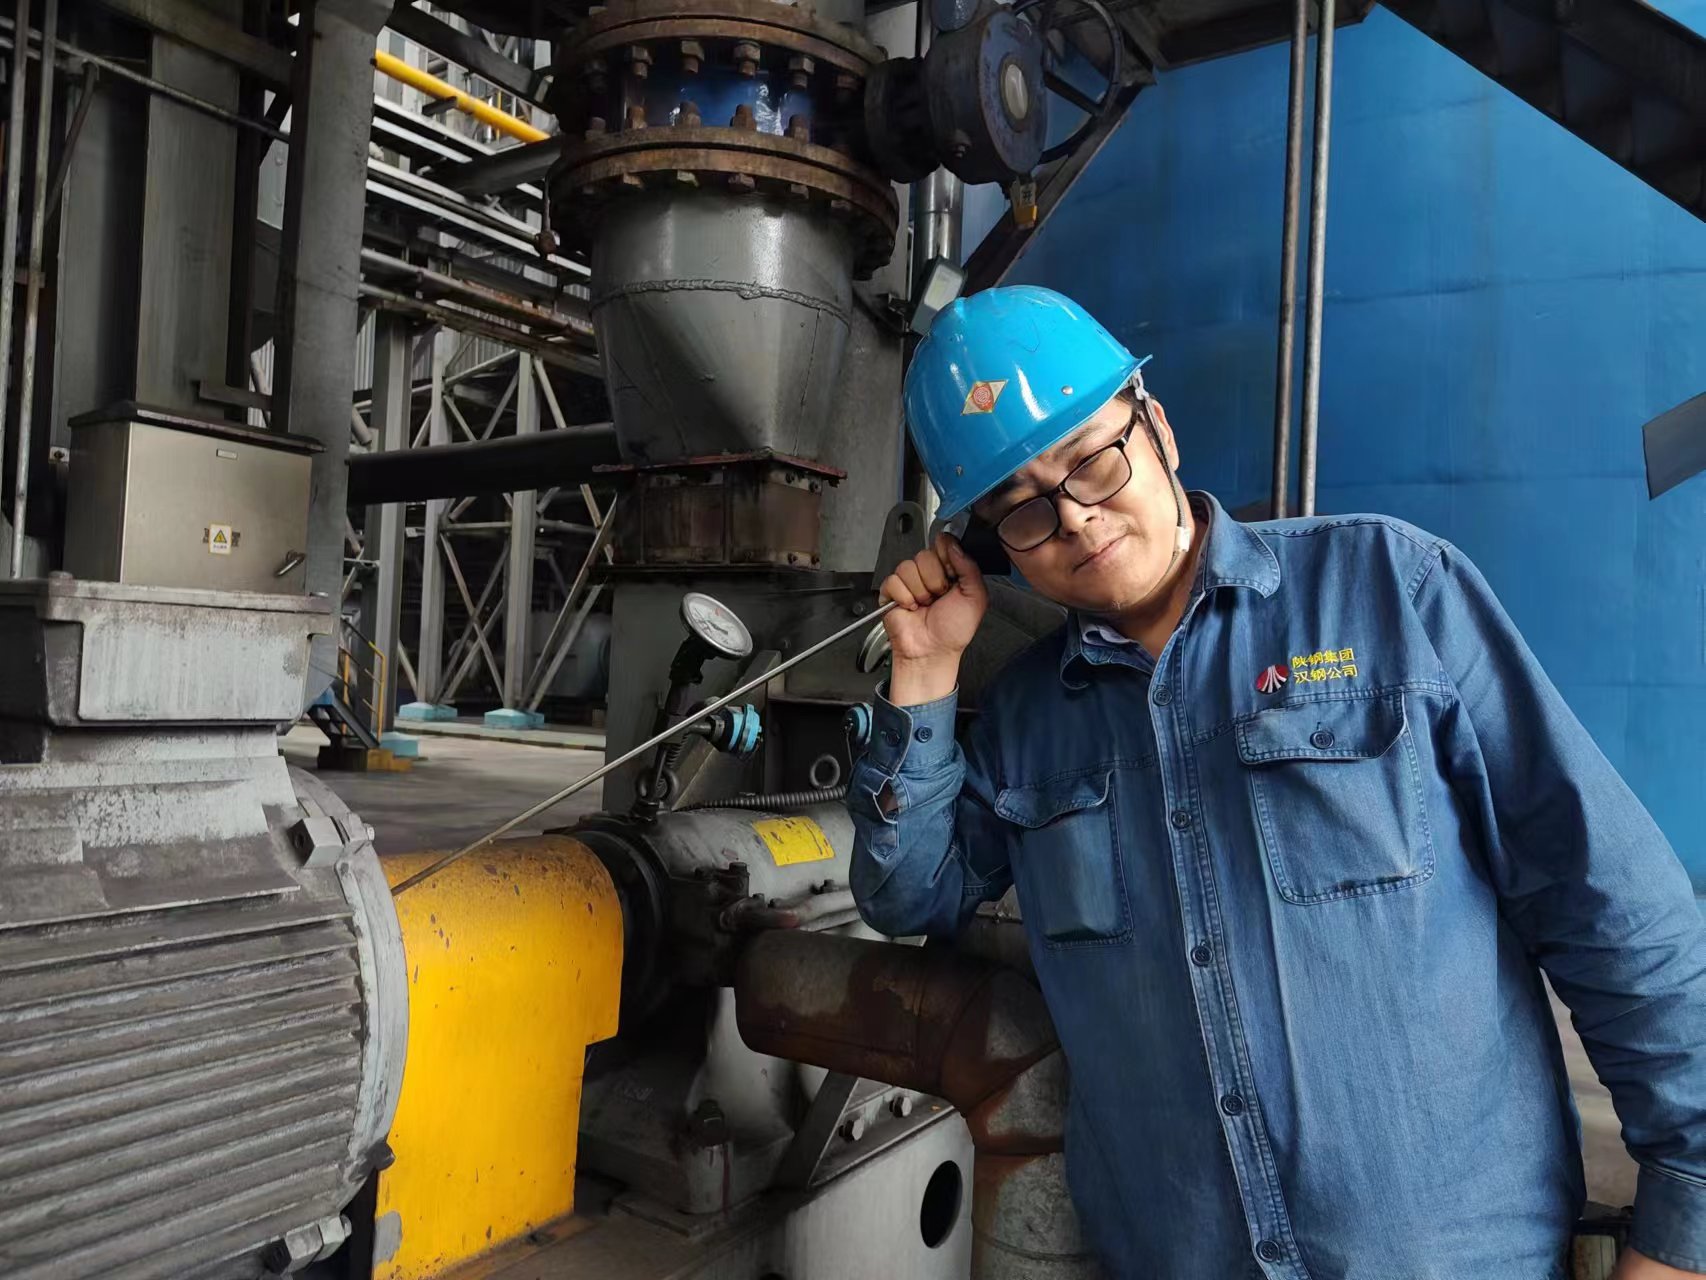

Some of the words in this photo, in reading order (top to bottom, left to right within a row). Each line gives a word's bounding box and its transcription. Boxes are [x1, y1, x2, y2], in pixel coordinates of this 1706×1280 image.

[1292, 648, 1354, 669] 陕钢集团
[1294, 664, 1358, 684] 汉钢公司
